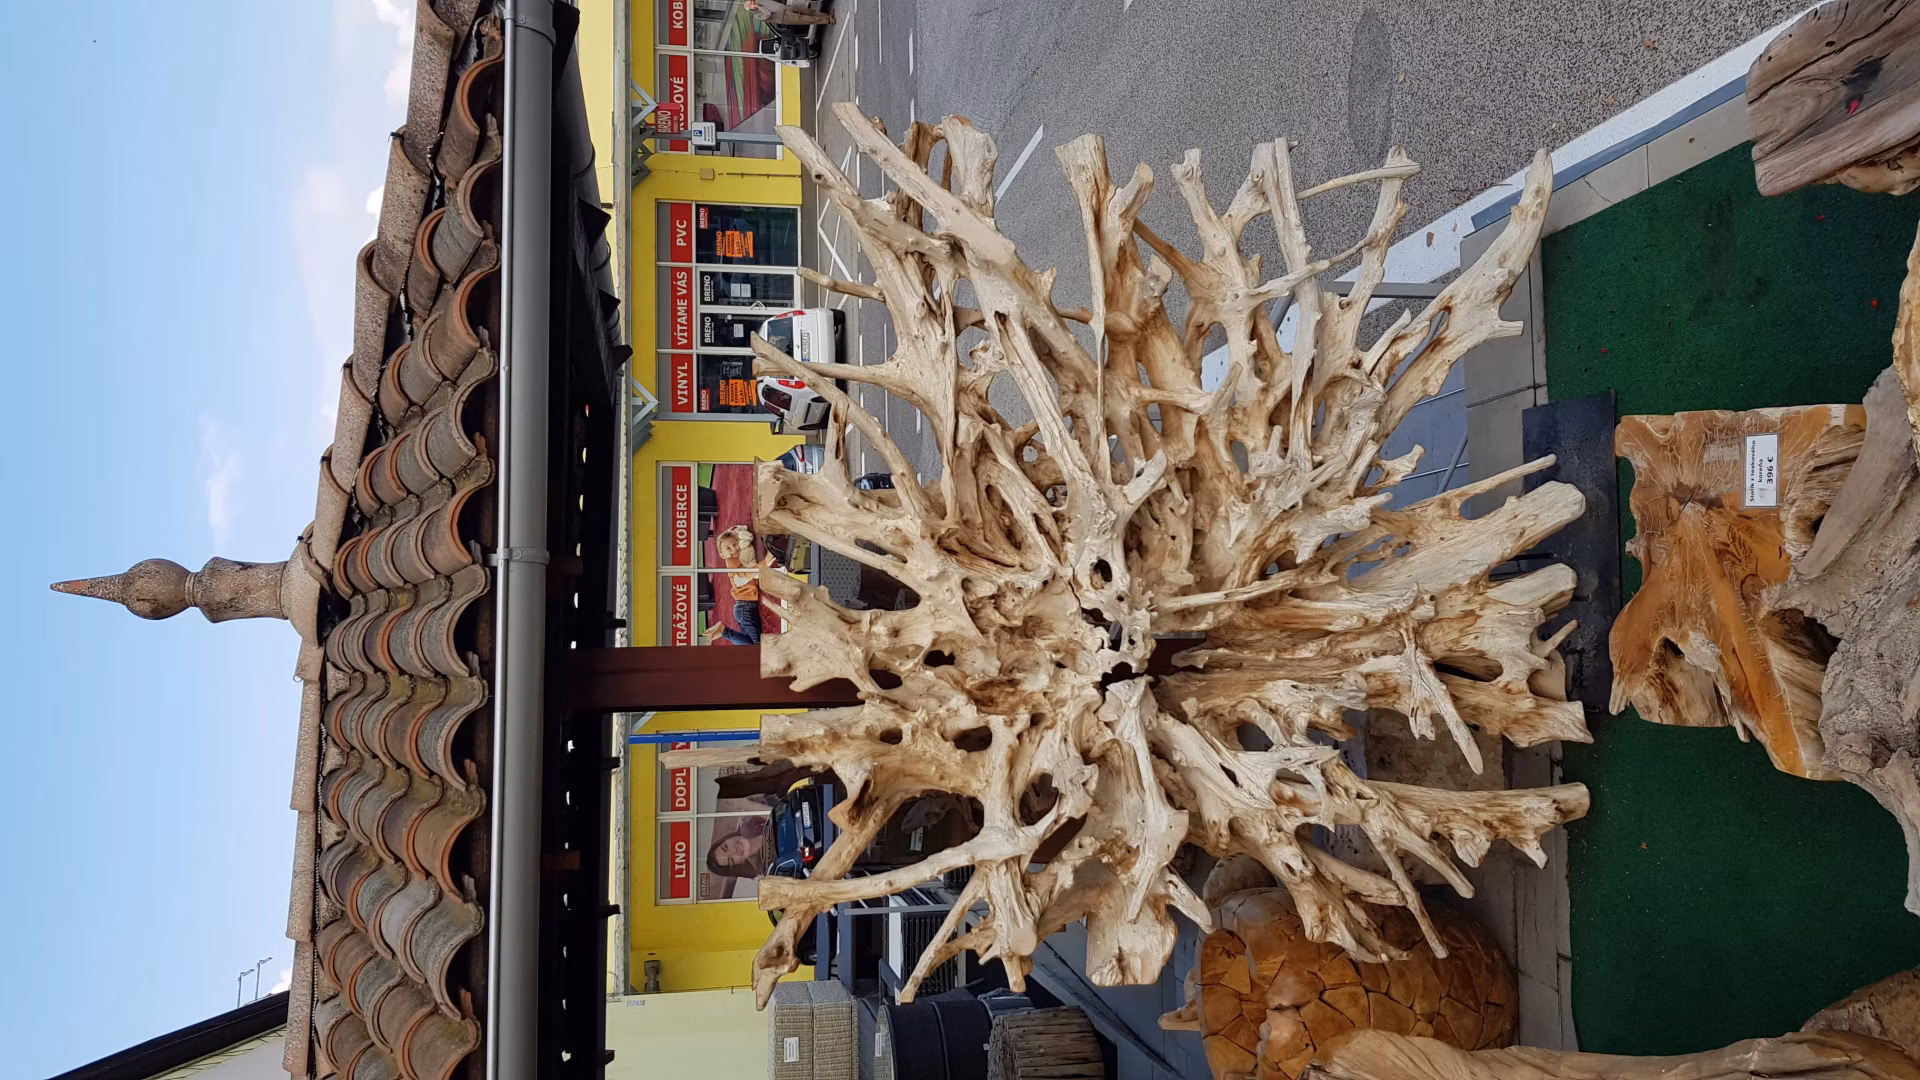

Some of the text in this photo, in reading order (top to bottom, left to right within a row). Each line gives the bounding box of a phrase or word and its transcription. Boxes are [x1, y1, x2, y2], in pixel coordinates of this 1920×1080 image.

[672, 0, 683, 28] KOB
[657, 111, 671, 132] BRENO
[676, 220, 687, 246] PVC
[673, 271, 688, 345] VÍTAME VÁS
[677, 362, 688, 405] VINYL
[676, 484, 687, 548] KOBERCE
[675, 742, 686, 807] DOPLY
[675, 841, 686, 878] LINO
